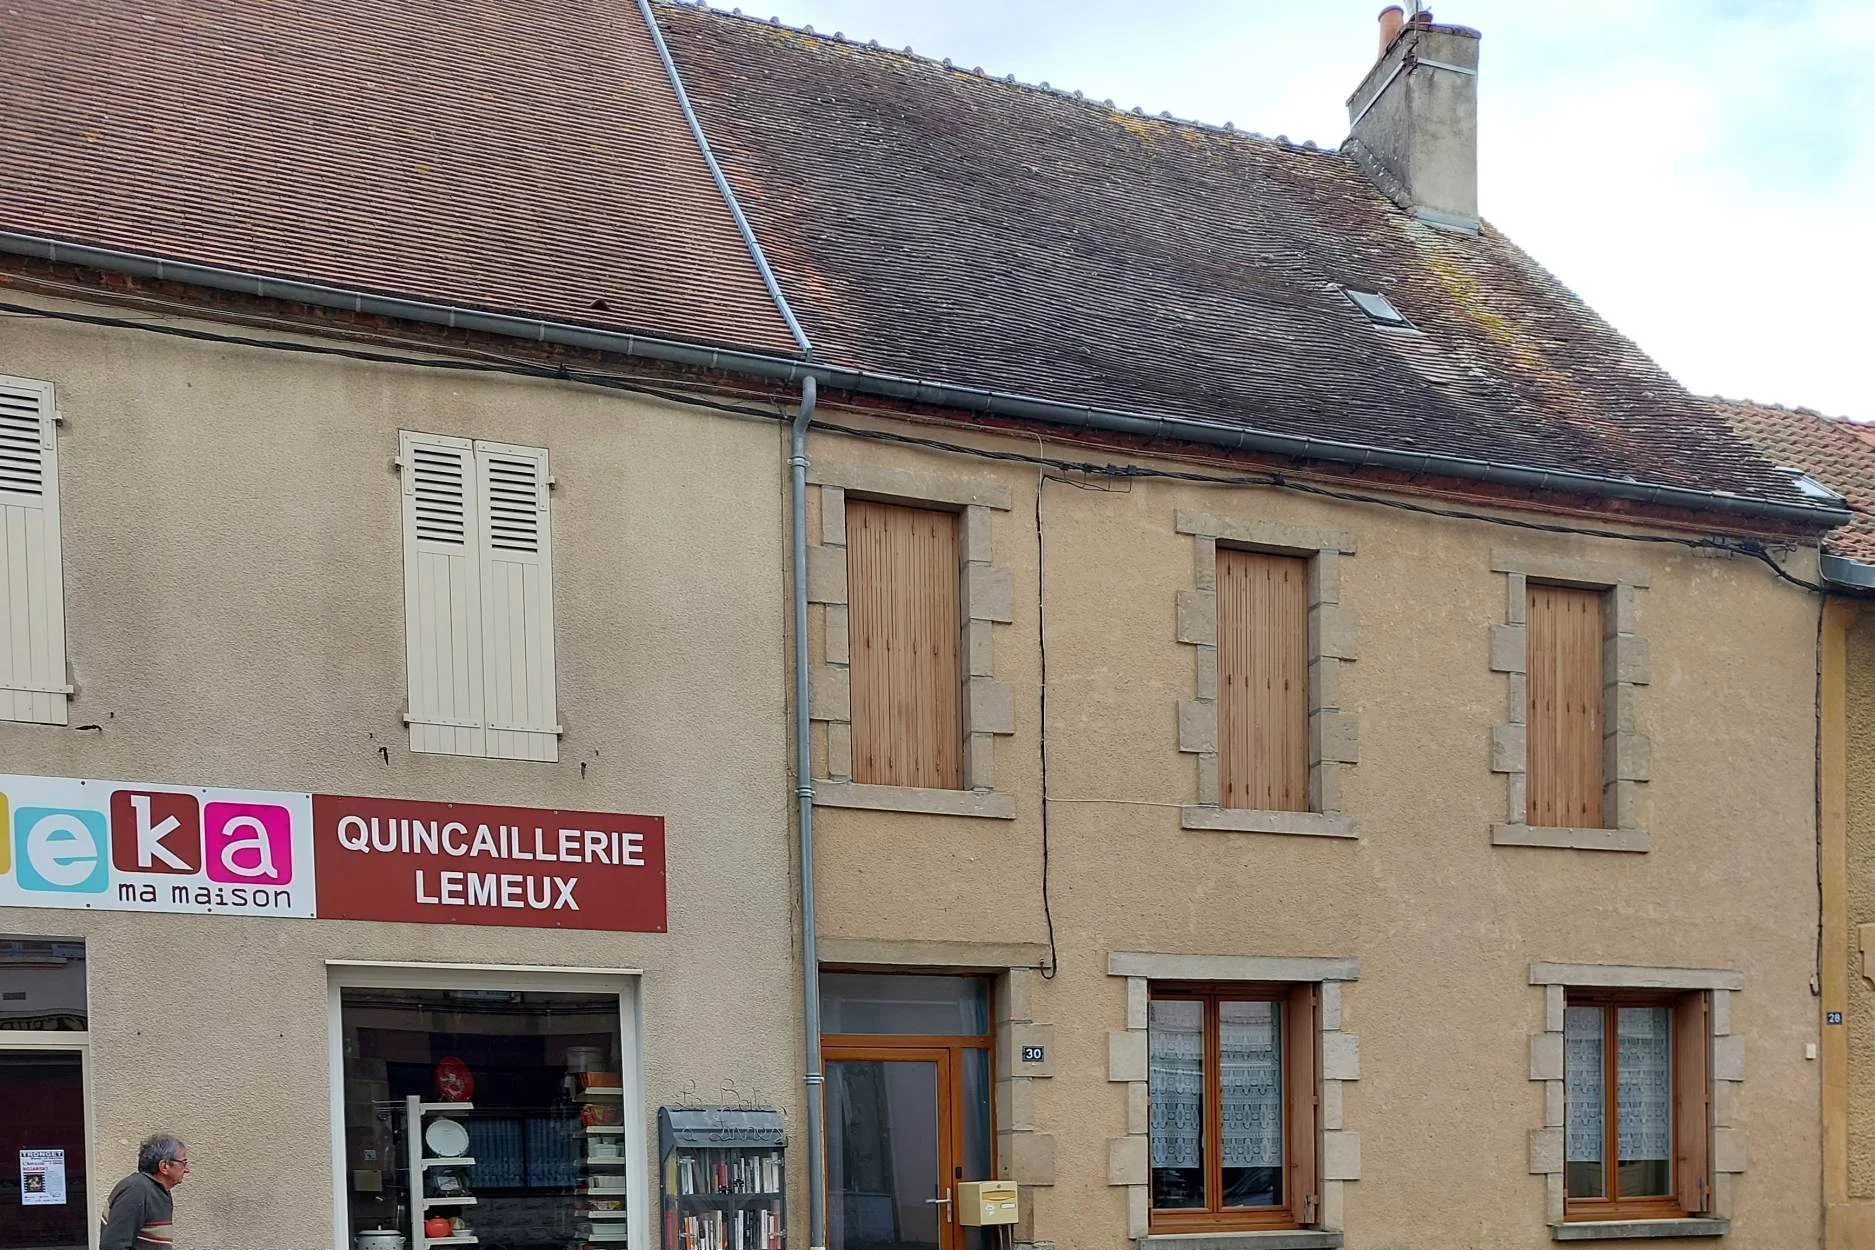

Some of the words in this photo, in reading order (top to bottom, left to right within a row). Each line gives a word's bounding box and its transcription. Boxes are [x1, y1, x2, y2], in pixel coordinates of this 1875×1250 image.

[337, 815, 644, 866] QUINCAILLERIE
[119, 881, 157, 903] ma
[172, 883, 292, 909] maison
[415, 870, 579, 911] LEMEUX
[1828, 1013, 1841, 1023] 28
[1025, 1048, 1042, 1059] 30
